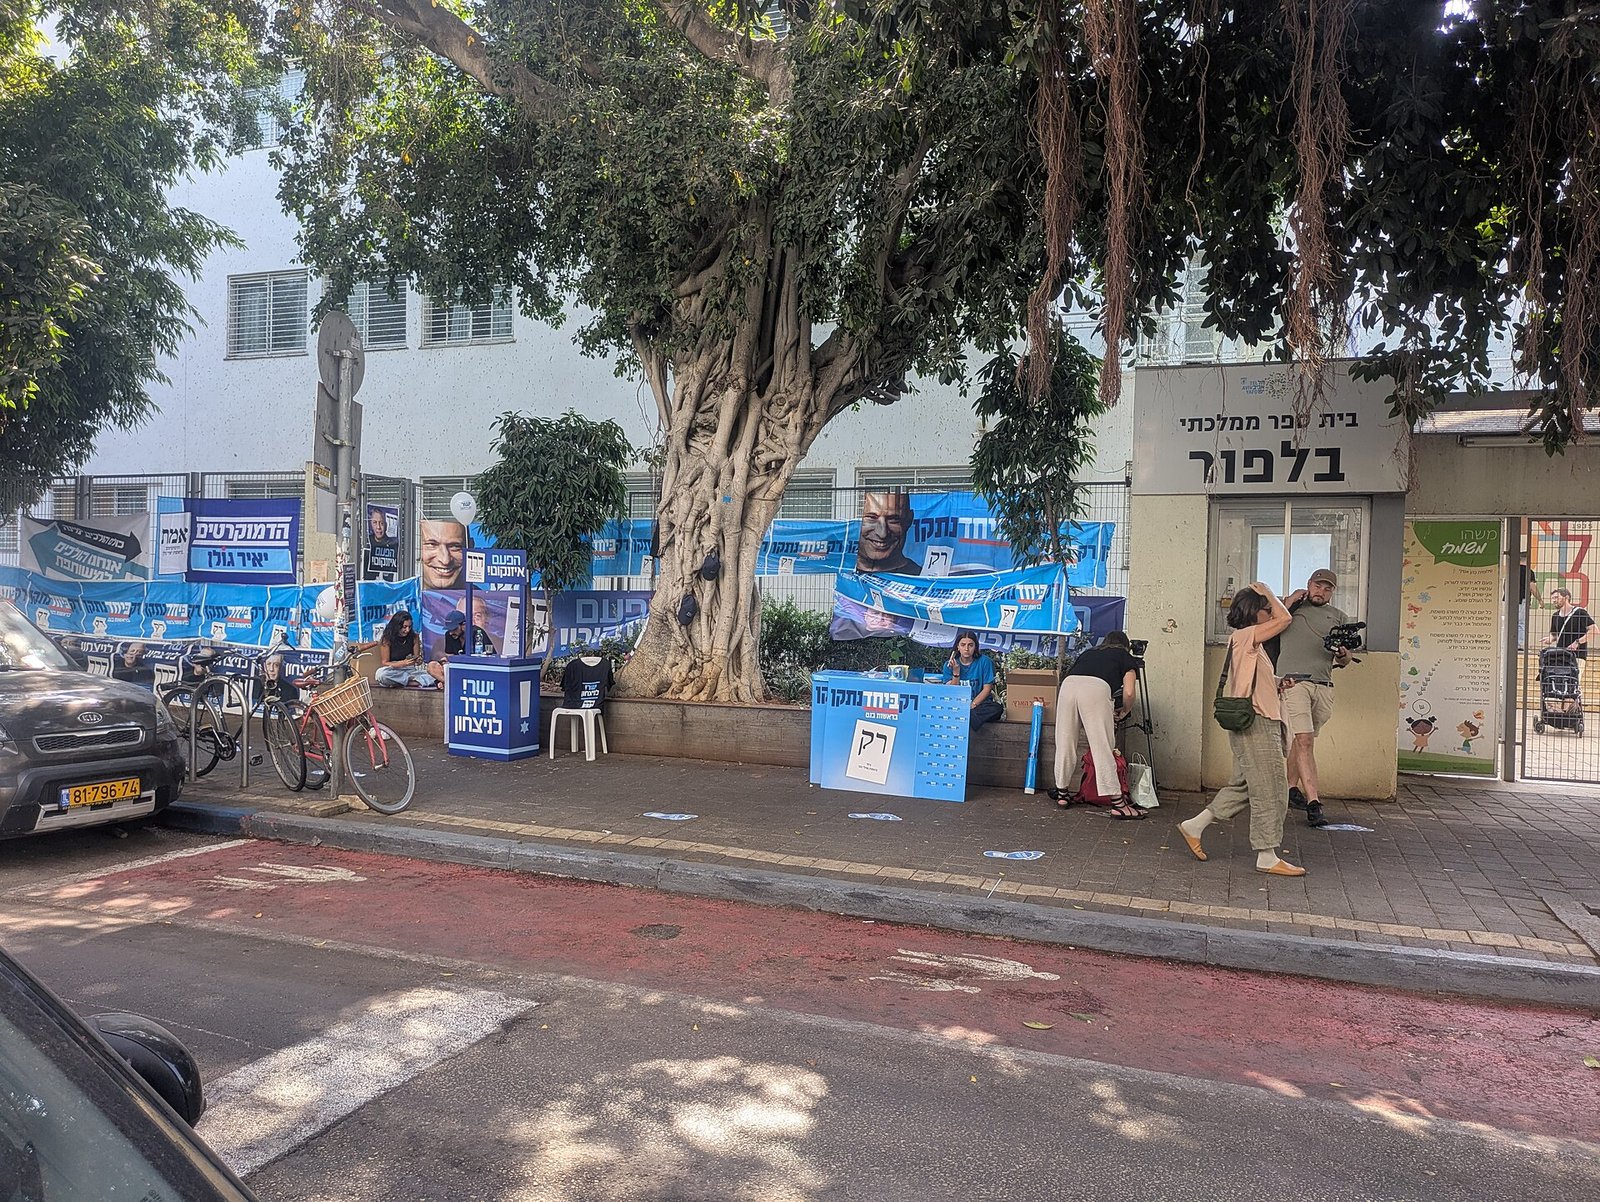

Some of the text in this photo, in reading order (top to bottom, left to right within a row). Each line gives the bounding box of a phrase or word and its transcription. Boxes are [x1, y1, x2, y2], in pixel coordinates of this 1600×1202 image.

[1179, 414, 1261, 432] ממלכתי
[1318, 412, 1359, 428] בית
[1188, 440, 1345, 484] בלפור
[161, 527, 188, 544] אמת
[195, 523, 290, 543] הדמוקרטים
[913, 516, 1003, 543] יחד נתקן
[1460, 529, 1498, 540] משהו
[53, 541, 91, 563] הולכים
[799, 541, 828, 553] ביחד
[1440, 541, 1488, 554] משמח
[207, 550, 269, 567] יאיר גולן
[491, 554, 521, 567] הפעם
[929, 551, 949, 569] רק
[487, 566, 526, 579] איזנקוט!
[1016, 584, 1048, 601] ביחד
[104, 602, 131, 614] ביחד
[165, 603, 189, 617] ביחד
[226, 606, 252, 619] ביחד
[362, 605, 387, 622] נתקן
[1003, 608, 1015, 620] רק
[80, 641, 114, 653] לניצחון
[462, 679, 495, 697] ישר!
[460, 696, 497, 716] בדרך
[831, 689, 864, 707] נתקן
[863, 691, 899, 710] ביחד
[898, 694, 919, 713] רק
[454, 715, 503, 736] לניצחון
[857, 729, 888, 756] רק
